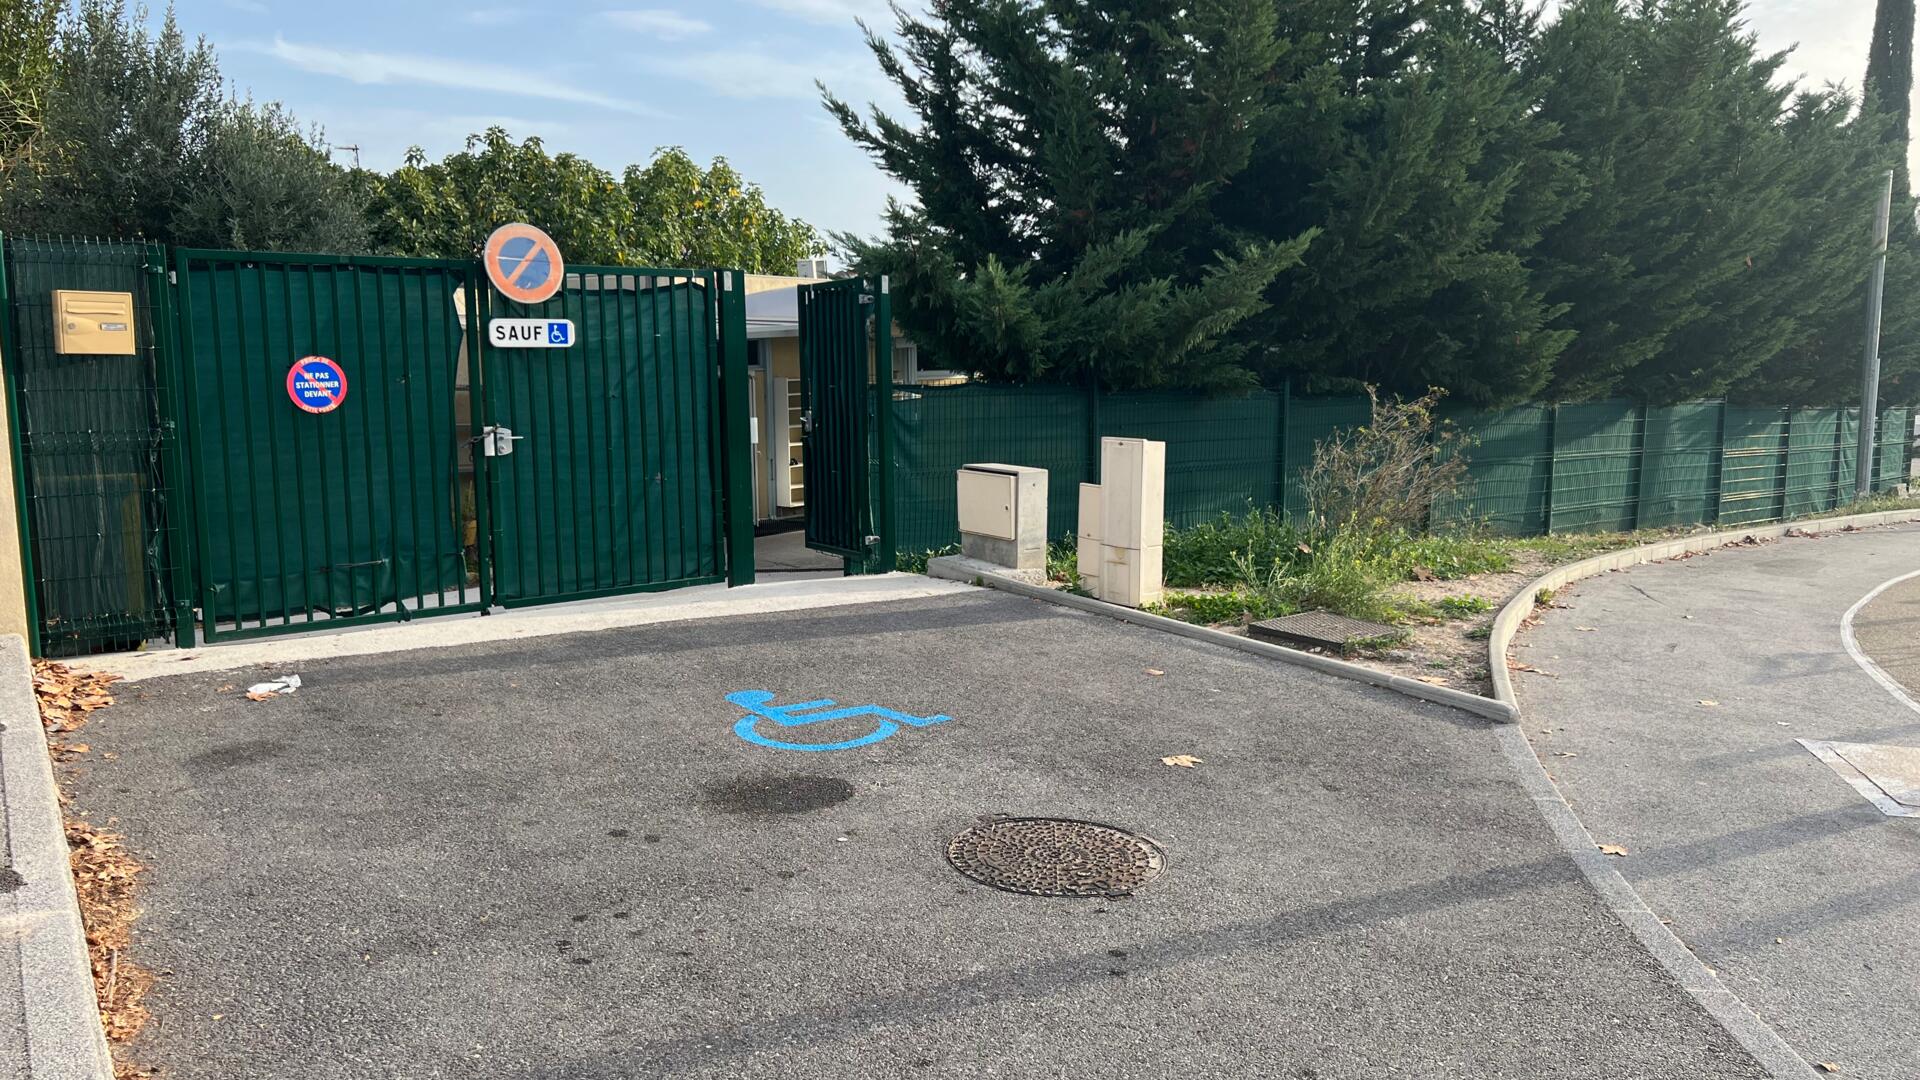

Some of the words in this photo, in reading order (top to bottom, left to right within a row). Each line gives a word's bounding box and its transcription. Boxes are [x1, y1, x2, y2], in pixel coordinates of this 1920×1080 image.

[496, 325, 542, 341] SAUF
[304, 372, 314, 380] NE
[295, 381, 339, 389] STATIONNER
[304, 390, 332, 398] DEVANT
